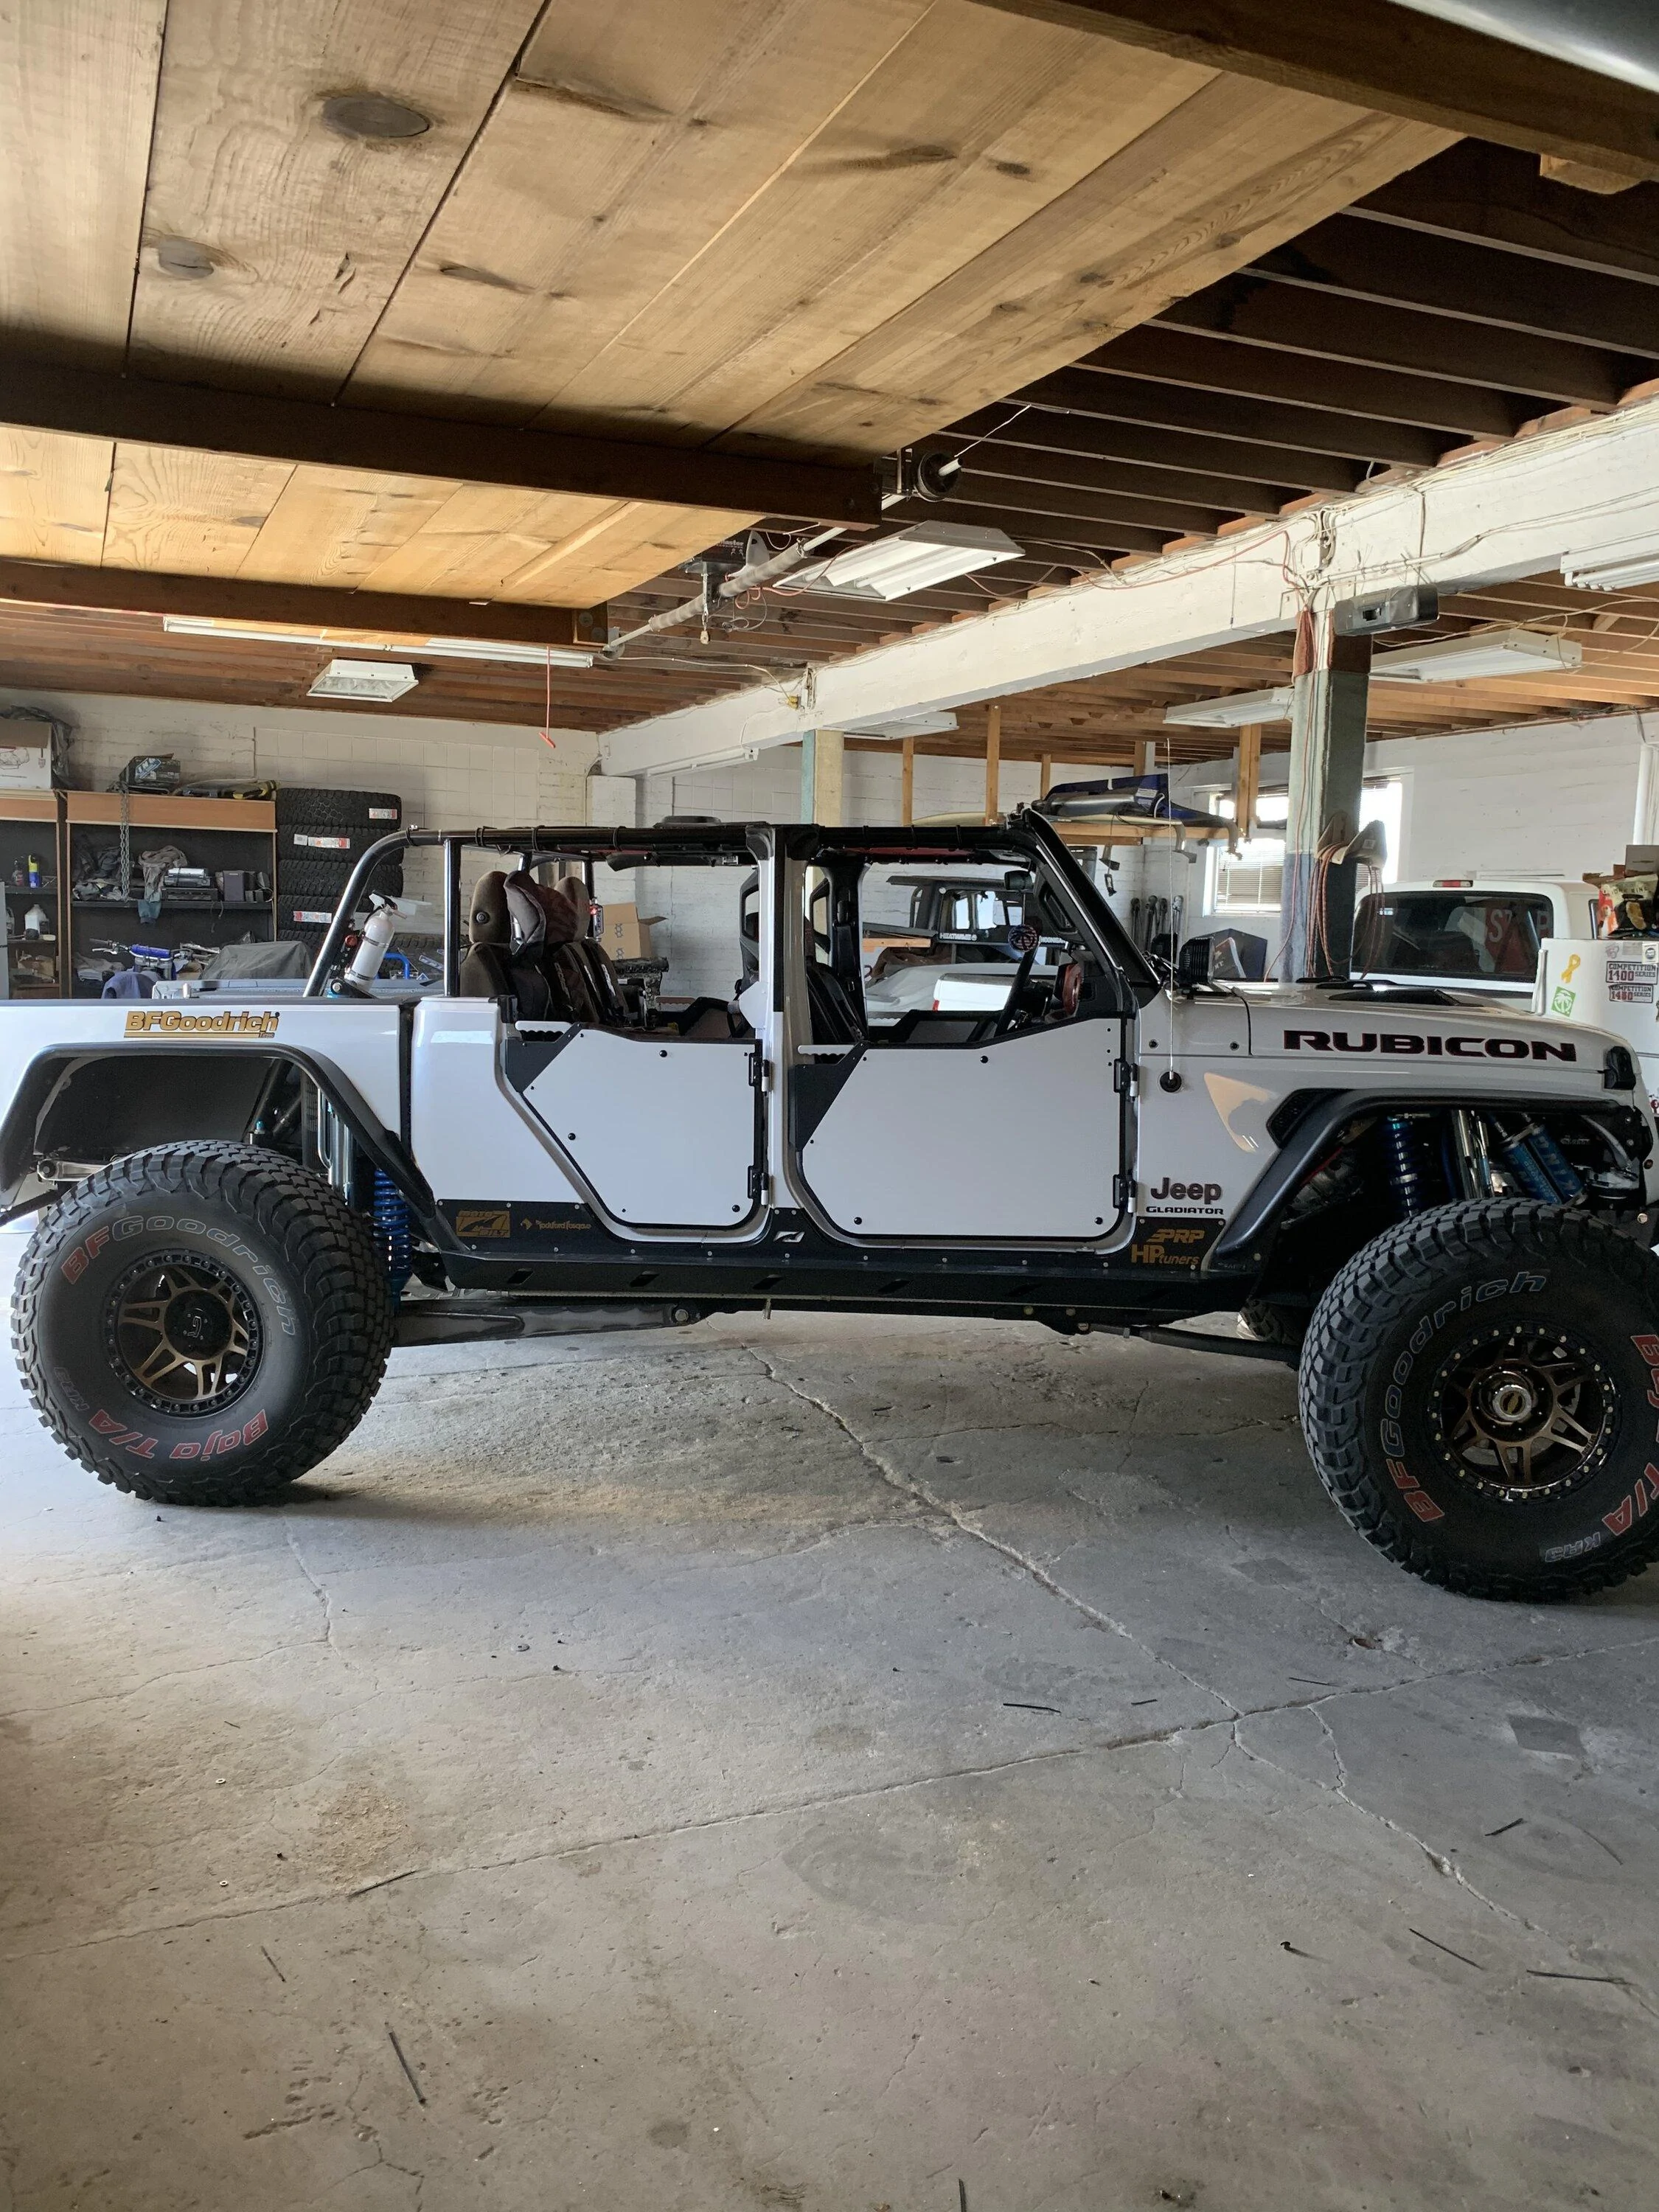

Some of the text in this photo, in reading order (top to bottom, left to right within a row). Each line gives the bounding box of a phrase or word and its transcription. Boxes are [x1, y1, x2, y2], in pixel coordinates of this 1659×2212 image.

[1609, 963, 1656, 971] COMPETITION
[125, 1011, 279, 1032] BFGoodrich
[1284, 1030, 1577, 1062] RUBICON
[1150, 1178, 1222, 1205] Jeep
[1146, 1206, 1224, 1215] GLADIATOR
[1147, 1228, 1205, 1243] PRP
[61, 1215, 296, 1336] BFGoodrich
[1380, 1271, 1546, 1523] BFGoodrich
[88, 1409, 269, 1461] Baja T/A
